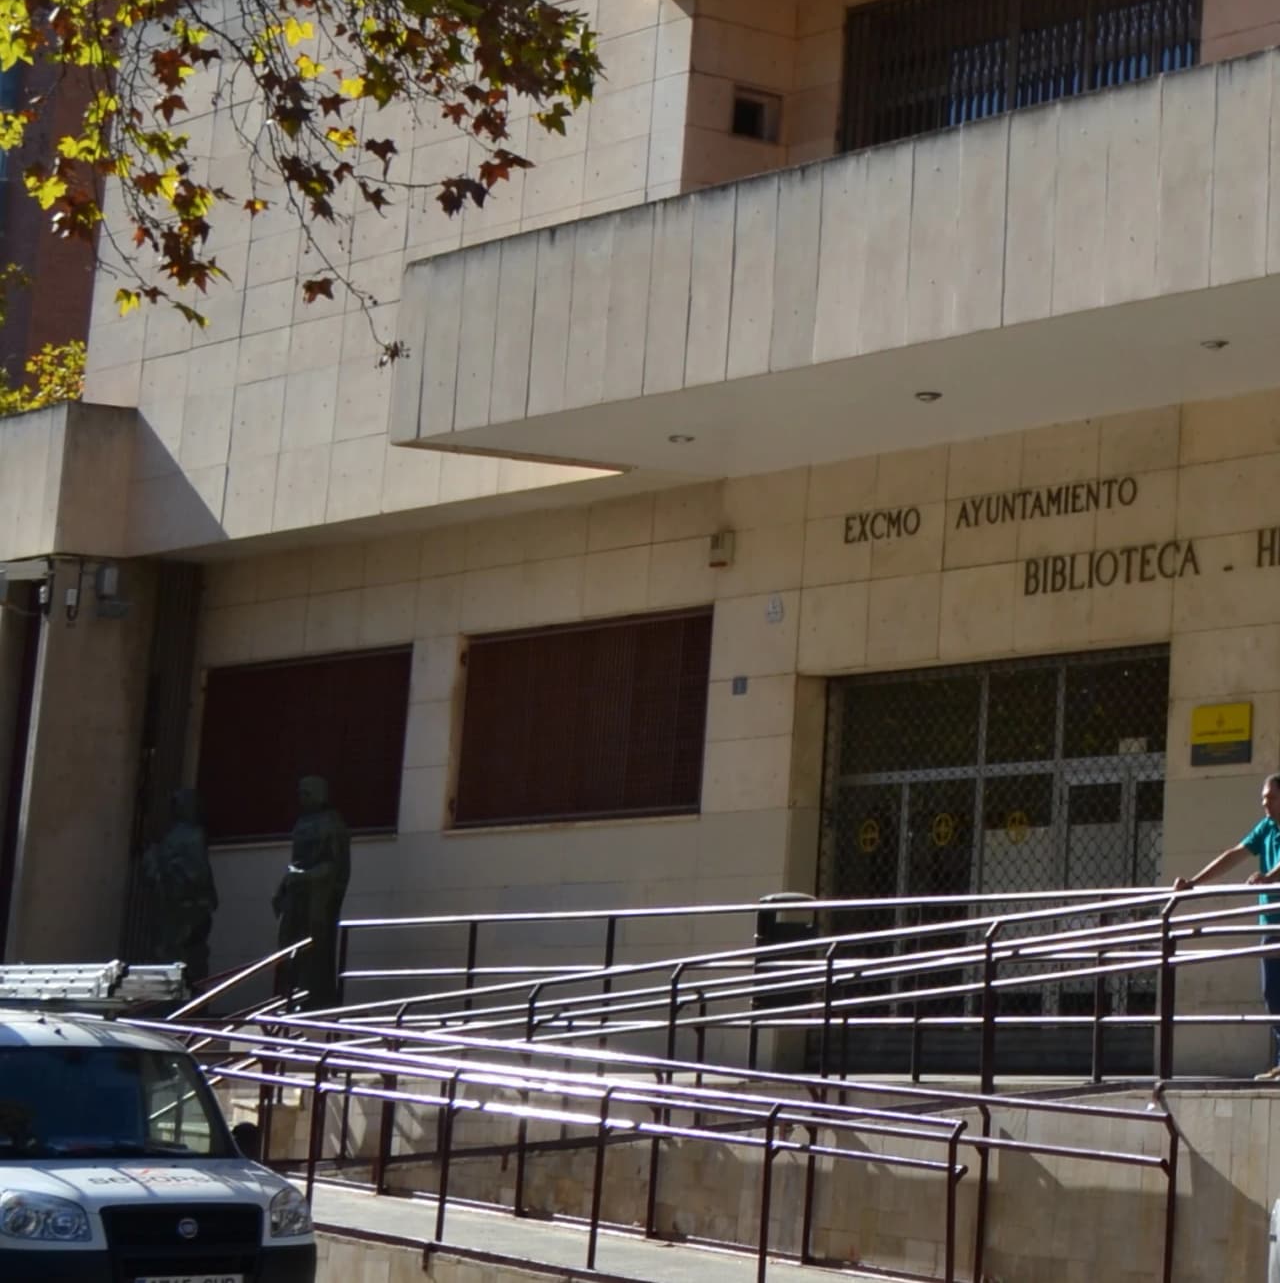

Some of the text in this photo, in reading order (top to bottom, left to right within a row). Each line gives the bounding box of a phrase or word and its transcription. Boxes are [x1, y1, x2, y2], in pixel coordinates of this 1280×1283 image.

[843, 476, 1138, 545] EXCMO AYUNTAMIENTO
[1024, 538, 1201, 597] BIBLIOTECA
